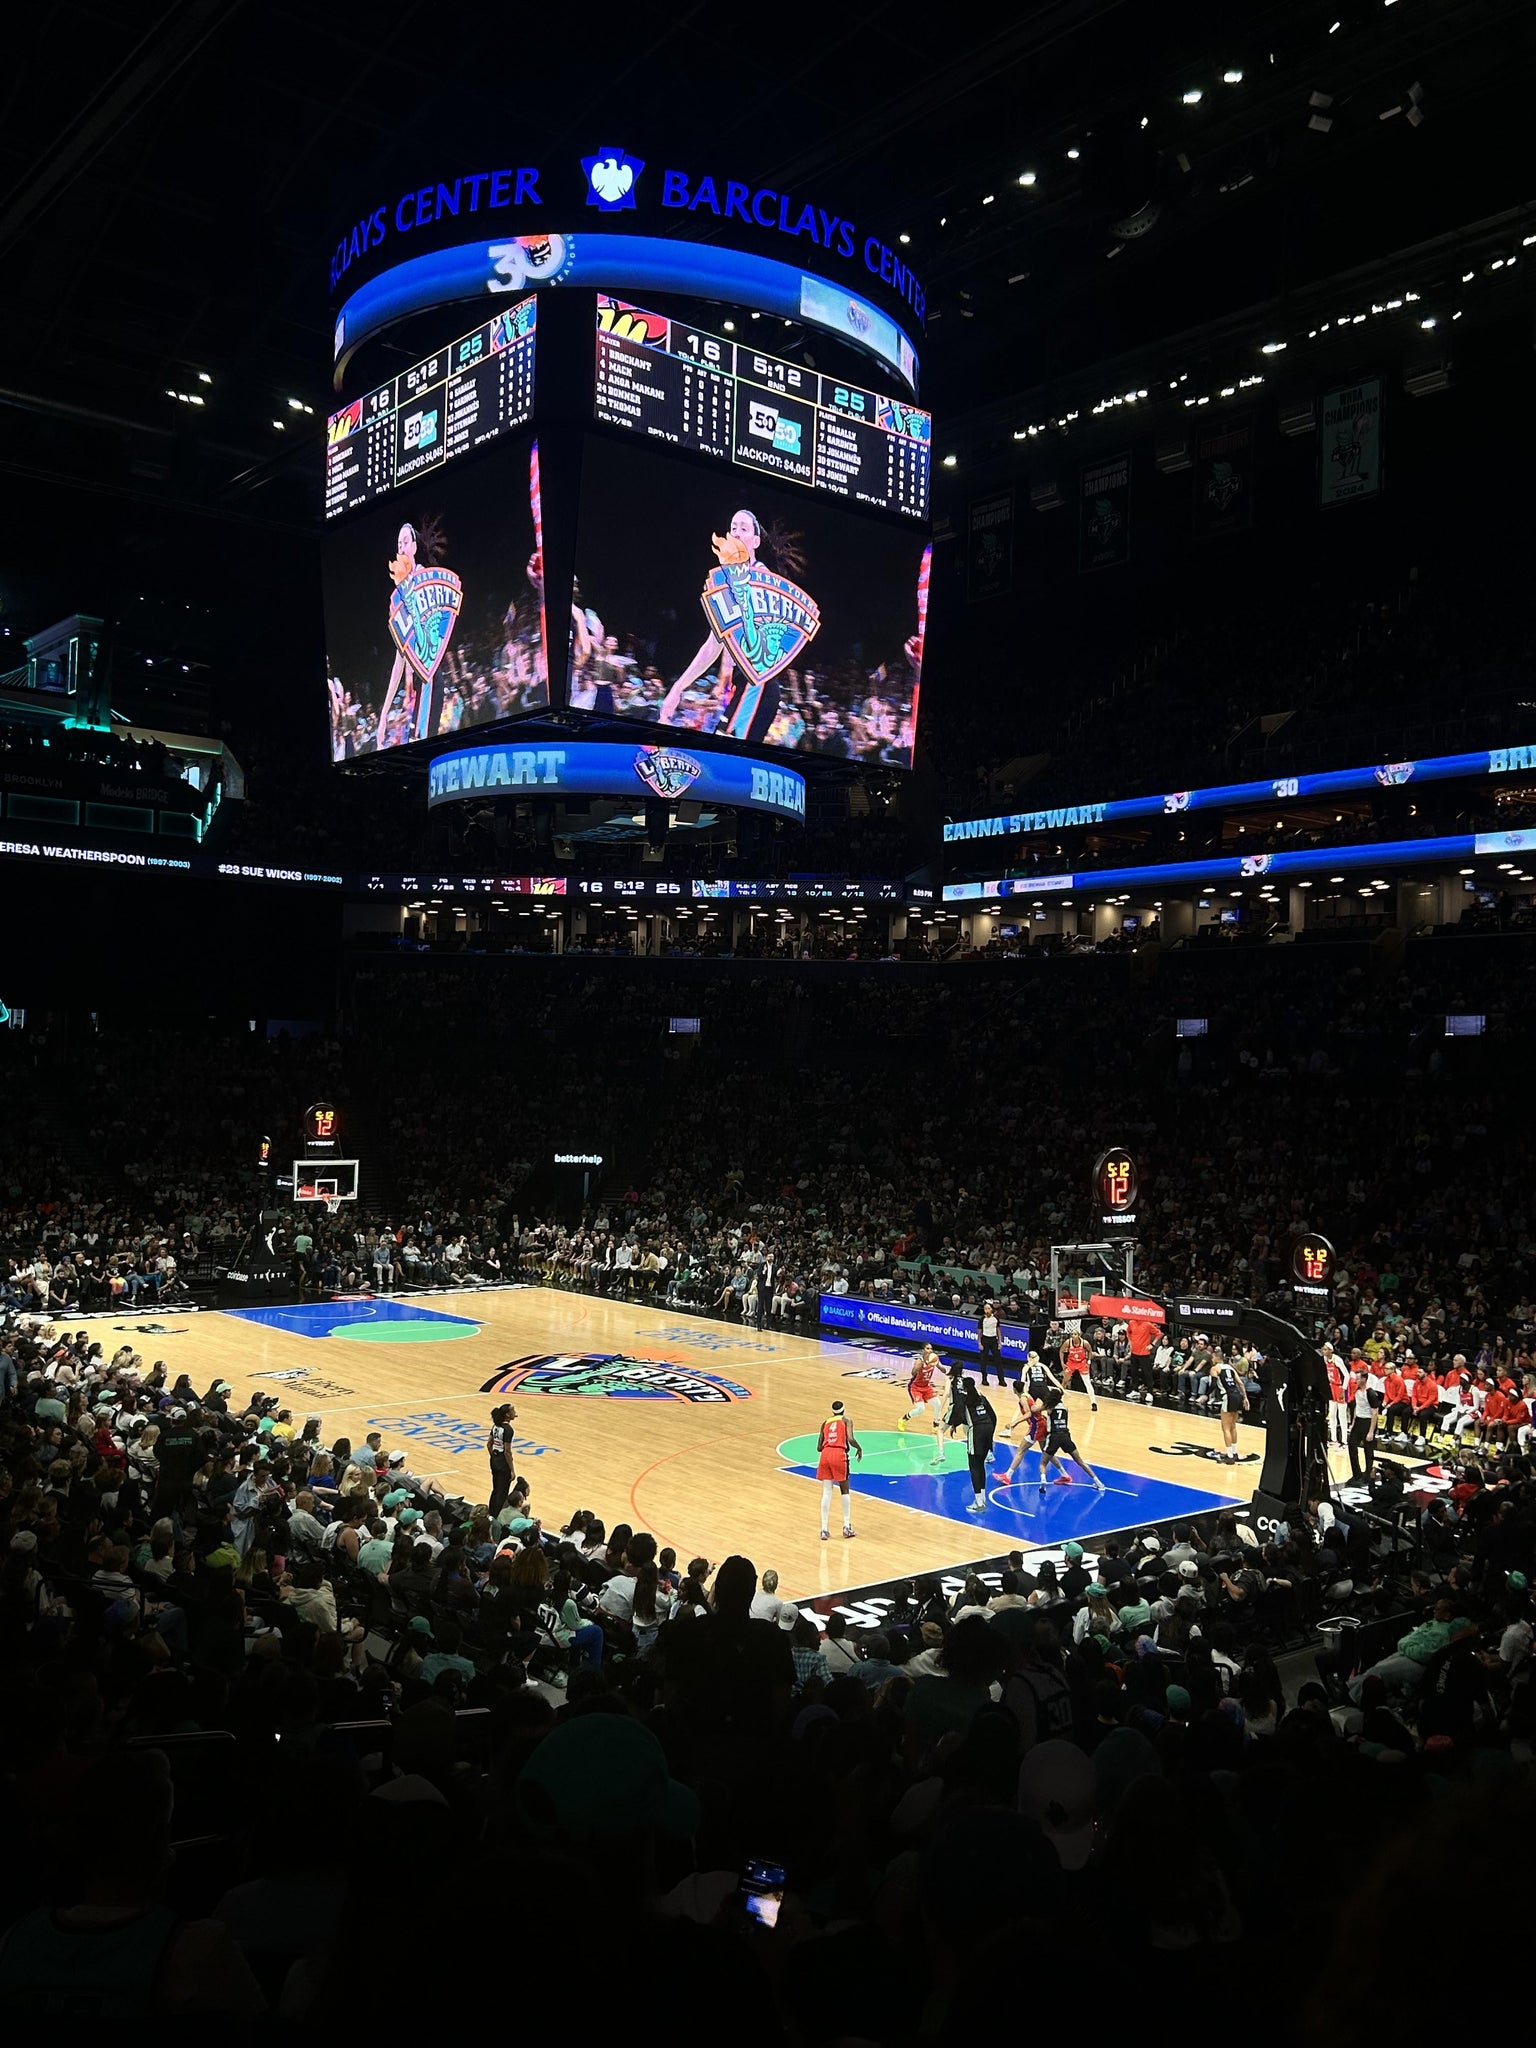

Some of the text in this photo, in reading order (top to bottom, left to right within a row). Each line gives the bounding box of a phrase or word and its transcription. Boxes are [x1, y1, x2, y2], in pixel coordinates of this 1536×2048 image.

[395, 167, 543, 232] CENTER
[662, 170, 855, 257] BARCLAYS
[460, 334, 482, 362] 25
[687, 334, 720, 361] 16
[407, 359, 438, 389] 5:12
[608, 361, 632, 378] MACK
[753, 355, 802, 388] 5:12
[370, 389, 389, 412] 16
[834, 386, 865, 412] 25
[754, 411, 776, 433] 50
[1325, 397, 1378, 426] CHAMPIONS
[737, 444, 783, 468] JACKPOT:
[784, 459, 811, 477] $4,045
[1335, 484, 1364, 498] 2024
[755, 571, 814, 610] NEW YORK
[135, 787, 169, 804] BRIDGE
[943, 803, 1107, 842] EANNA STEWART
[0, 841, 40, 856] ERESA
[43, 846, 145, 866] WEATHERSPOON
[241, 866, 264, 877] SUE
[265, 868, 302, 881] WICKS
[579, 880, 681, 894] 16 5:12 25
[317, 1120, 332, 1136] 12
[554, 1153, 603, 1165] betterhelp
[1111, 1177, 1128, 1204] 12
[1112, 1214, 1136, 1224] TISSOT
[1307, 1261, 1323, 1278] 12
[829, 1306, 854, 1318] BARCLAYS
[1192, 1307, 1215, 1315] LUXURY
[867, 1312, 891, 1325] Official
[891, 1315, 917, 1332] Banking
[917, 1321, 943, 1335] Partner
[943, 1325, 952, 1336] of
[952, 1327, 964, 1338] the
[282, 1380, 341, 1399] Mutual
[303, 1378, 356, 1394] Liberty
[1056, 1409, 1063, 1420] 7
[366, 1417, 484, 1455] CENTER
[829, 1421, 837, 1432] 4
